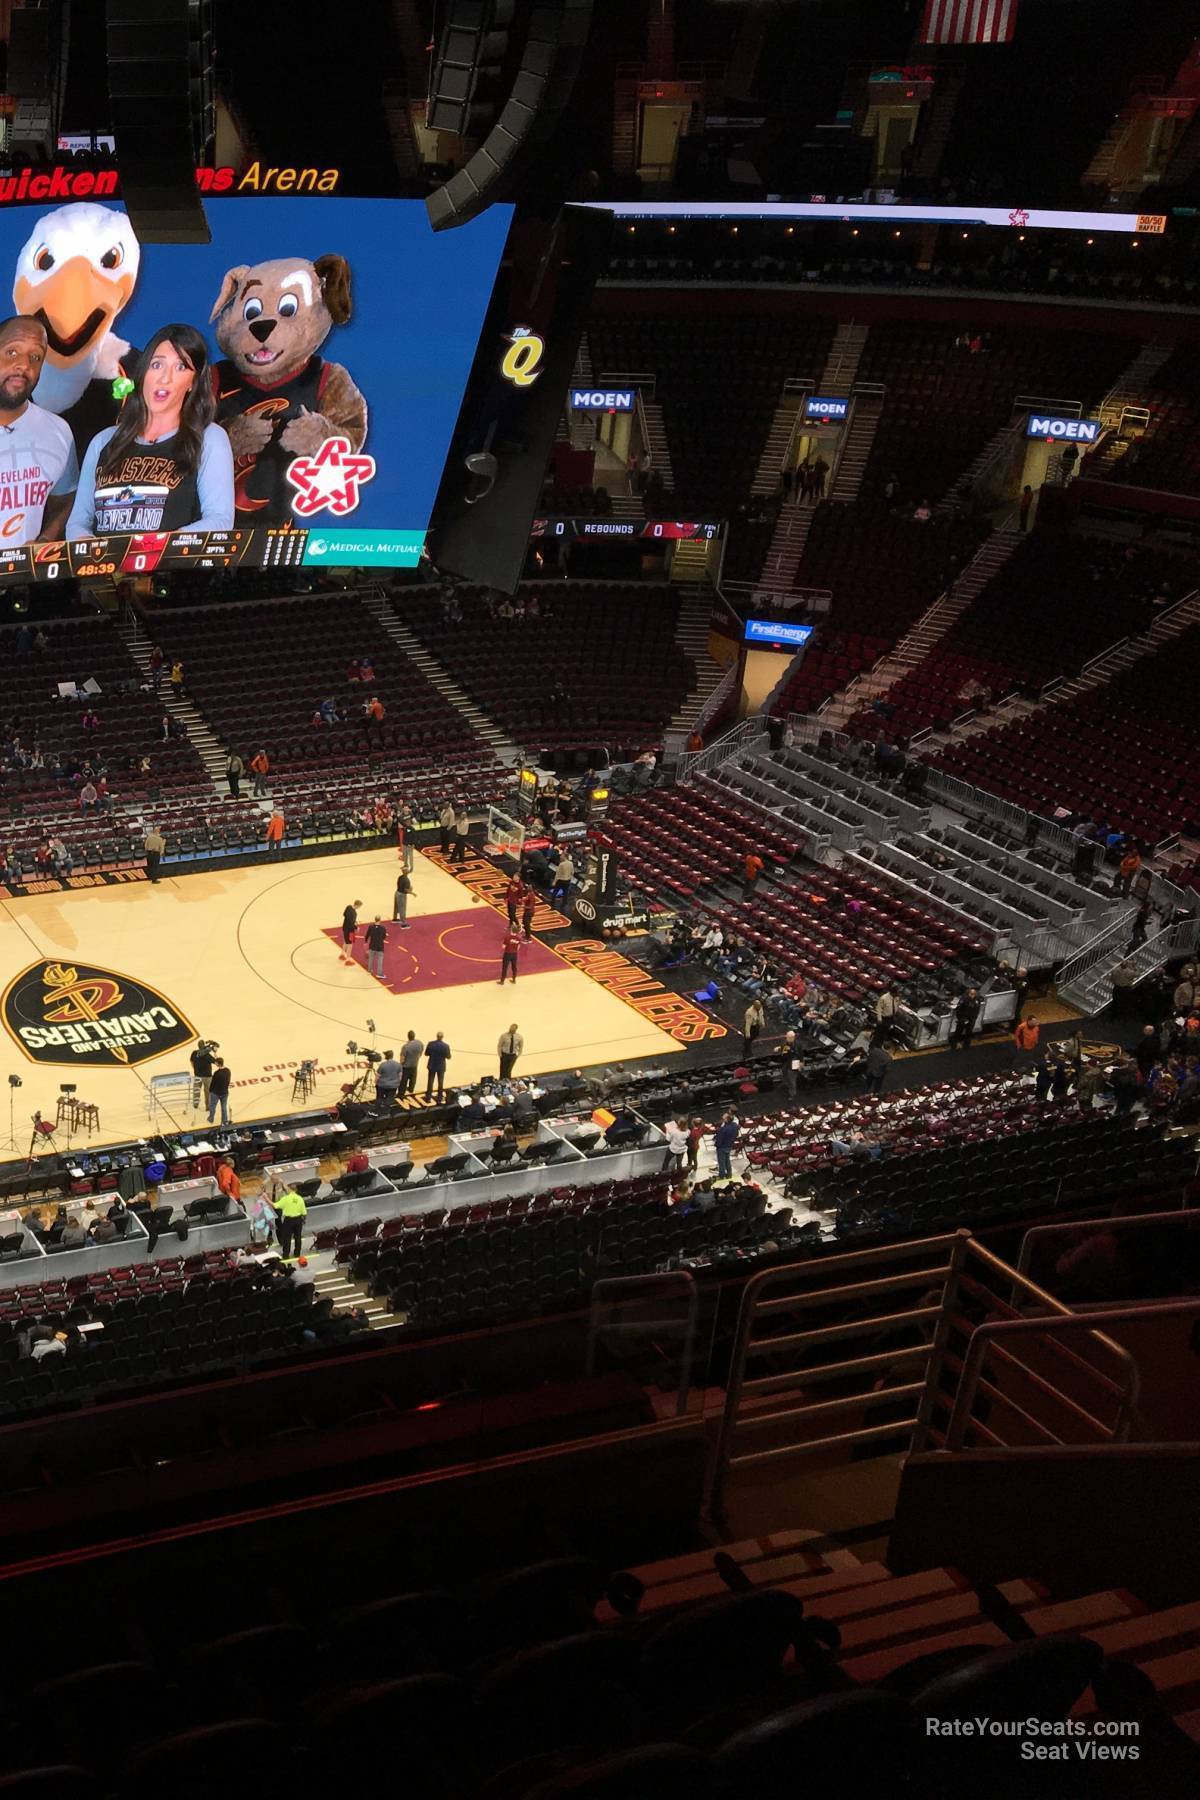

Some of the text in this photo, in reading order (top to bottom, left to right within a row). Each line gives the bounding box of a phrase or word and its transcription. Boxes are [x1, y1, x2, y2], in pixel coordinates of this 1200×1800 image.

[239, 161, 338, 191] Arena
[1139, 216, 1163, 225] 50/50
[502, 336, 543, 385] Q
[574, 393, 631, 407] MOEN
[808, 402, 846, 414] MOEN
[1031, 418, 1096, 438] MOEN
[555, 523, 564, 535] 0
[584, 524, 635, 534] REBOUNDS
[654, 525, 662, 536] 0
[329, 542, 419, 553] MEDICAL MUTUAL
[135, 555, 146, 569] 0
[47, 563, 59, 578] 0
[76, 563, 115, 576] 48:39
[751, 623, 811, 640] FirstEnergy
[70, 874, 104, 888] FOR
[110, 868, 148, 882] ALL
[603, 917, 624, 928] drug
[554, 939, 728, 1042] CAVALIERS
[18, 1006, 178, 1048] CAVALIERS
[71, 1033, 152, 1054] CLEVELAND
